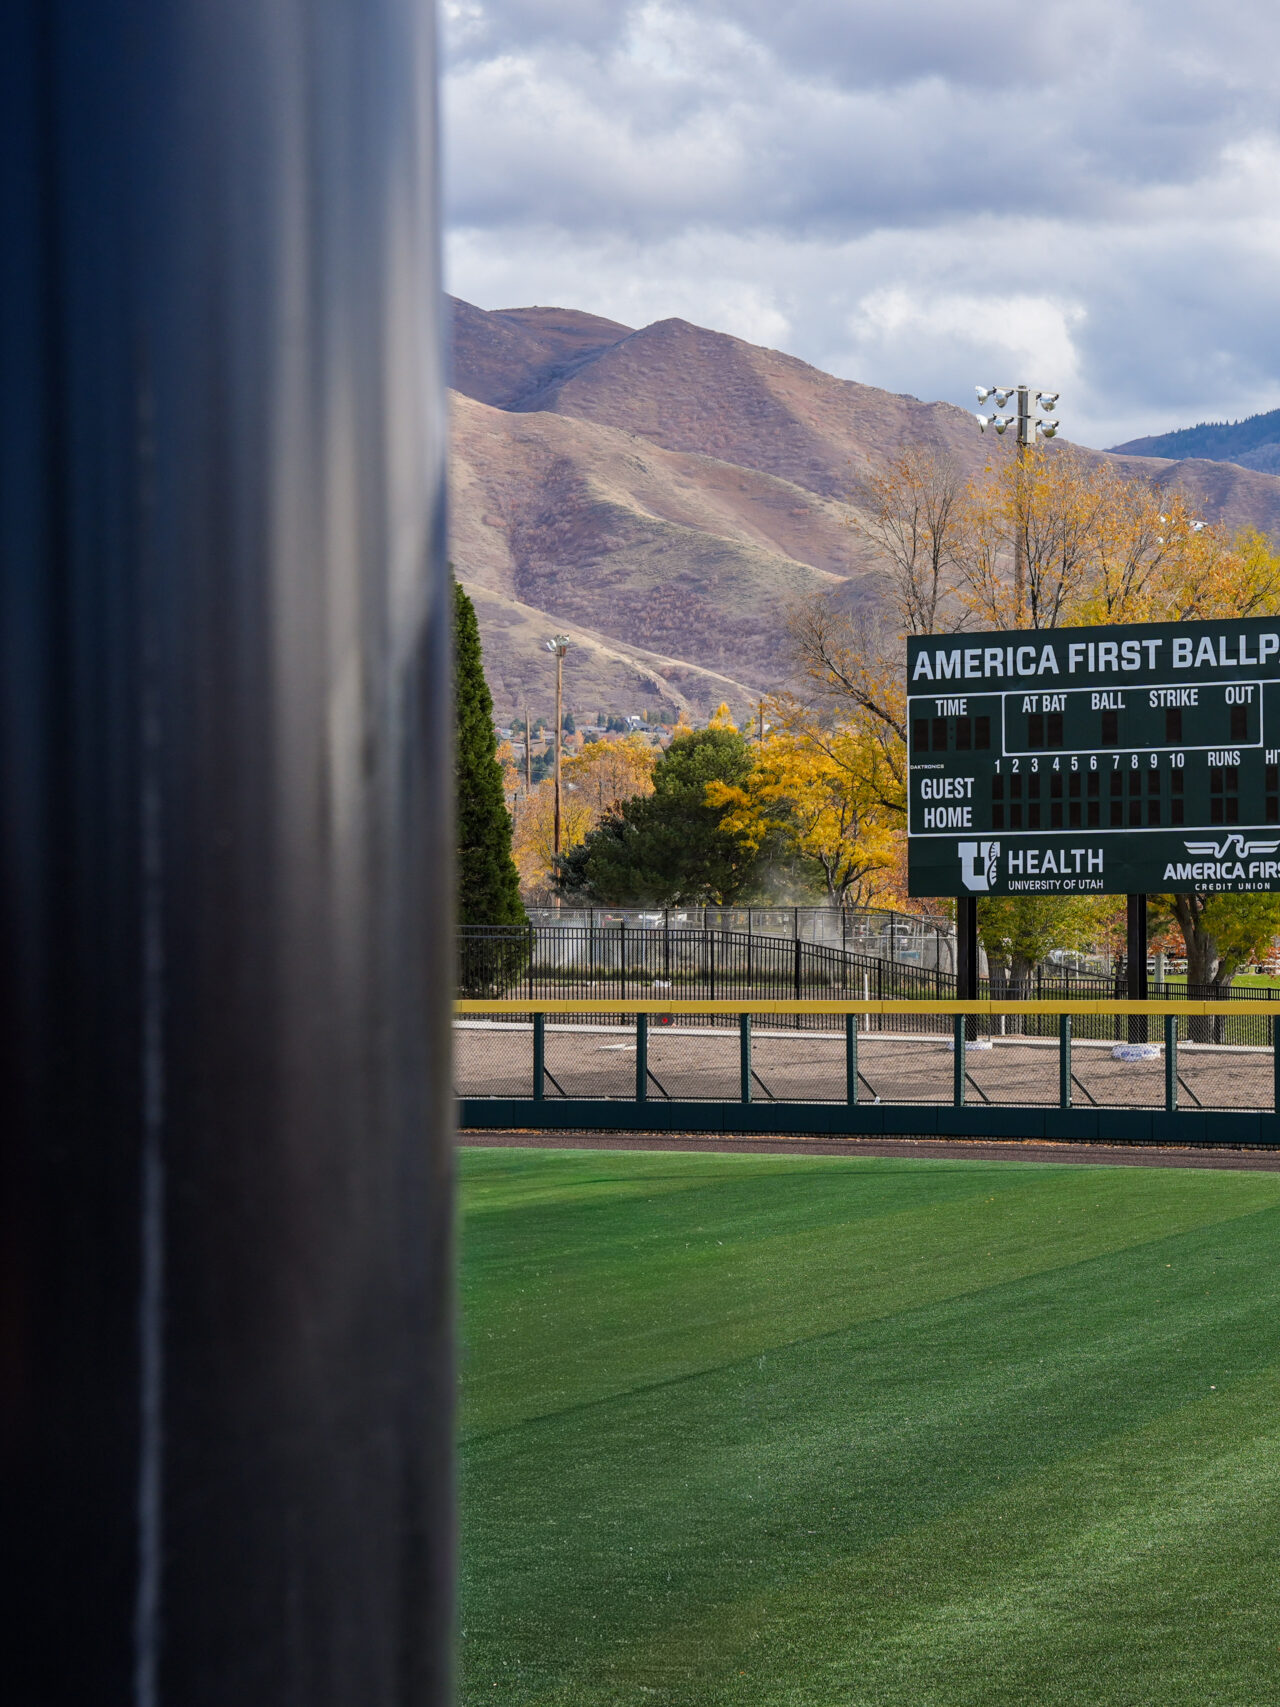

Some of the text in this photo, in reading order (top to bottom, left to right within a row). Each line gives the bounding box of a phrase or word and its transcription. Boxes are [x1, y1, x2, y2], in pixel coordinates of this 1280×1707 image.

[912, 645, 1059, 680] AMERICA
[1069, 639, 1162, 673] FIRST
[1021, 695, 1067, 714] AT BAT
[1092, 692, 1125, 710] BALL
[1148, 687, 1198, 707] STRIKE
[1225, 686, 1254, 704] OUT
[935, 699, 967, 716] TIME
[994, 752, 1185, 774] 1 2 3 4 5 6 7 8 9 10
[1208, 751, 1240, 766] RUNS
[921, 778, 974, 799] GUEST
[925, 807, 972, 828] HOME
[957, 841, 1001, 891] U
[1009, 849, 1103, 874] HEALTH
[1163, 862, 1246, 880] AMERICA
[1009, 879, 1103, 891] UNIVERSITY OF UTAH
[1195, 883, 1270, 891] CREDIT UNION
